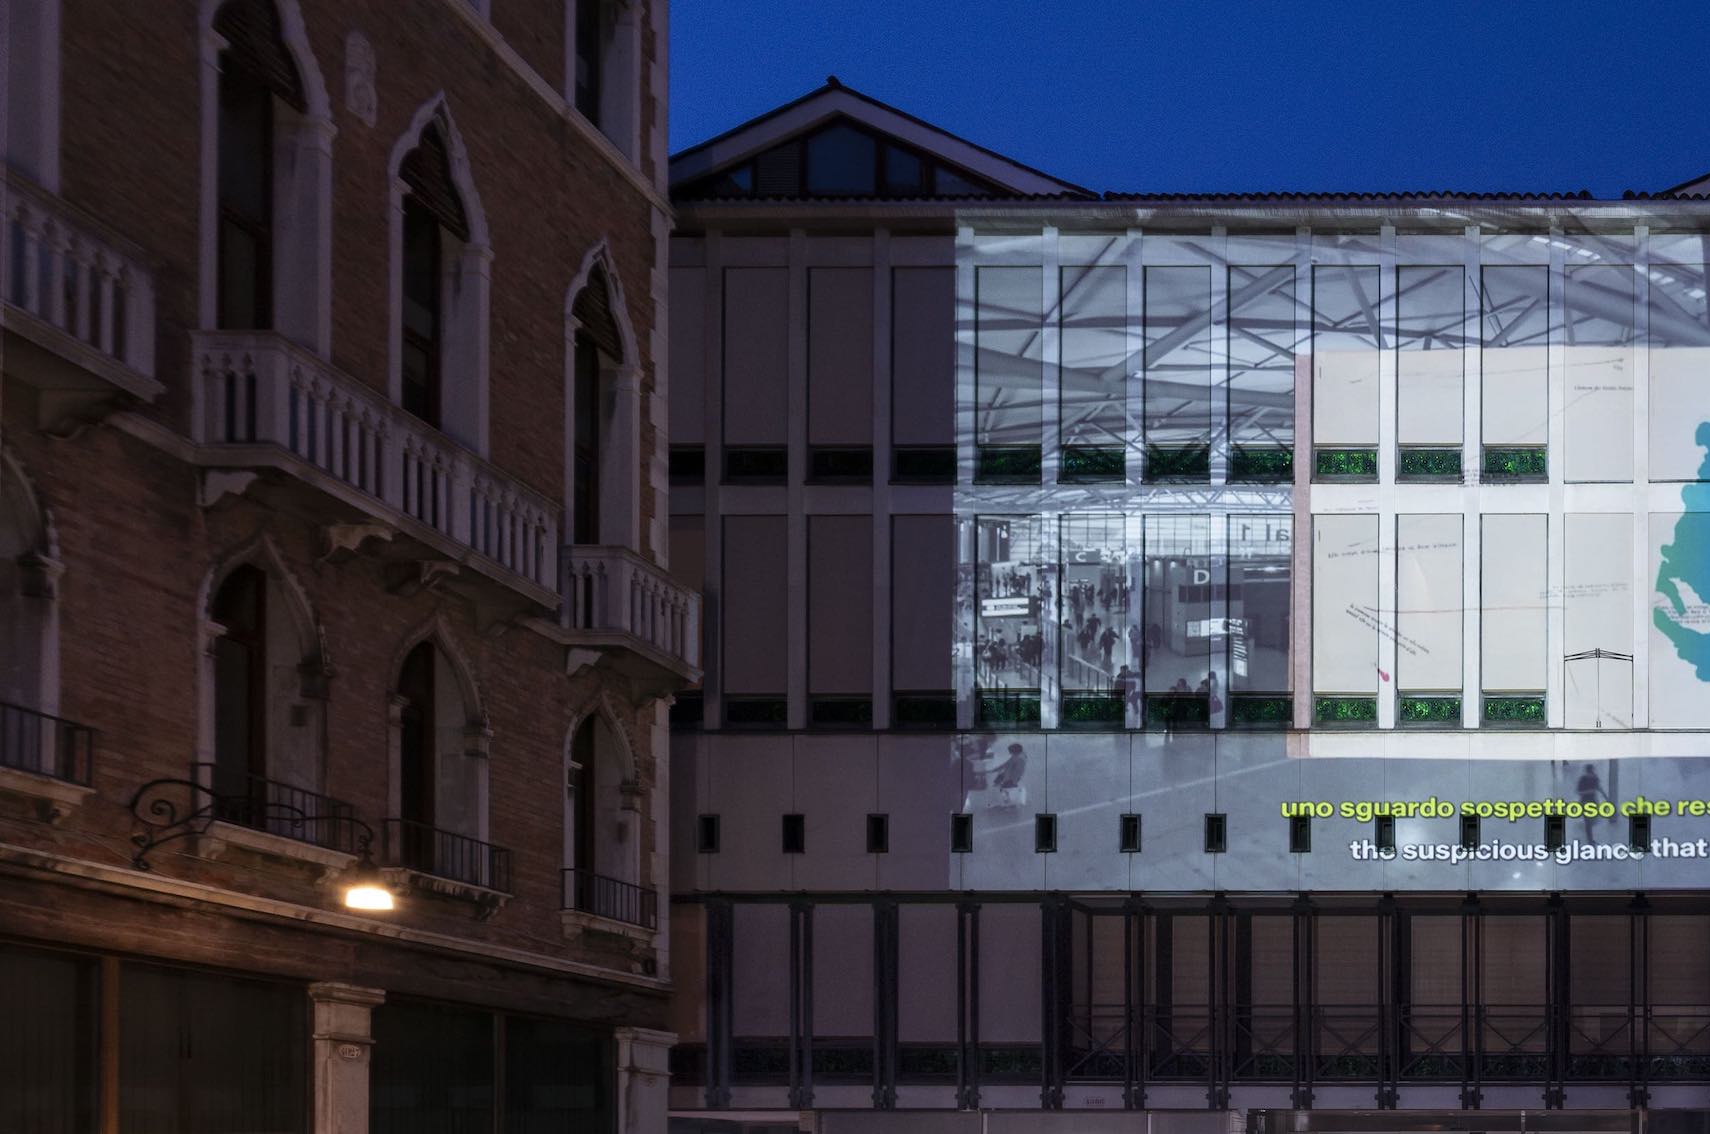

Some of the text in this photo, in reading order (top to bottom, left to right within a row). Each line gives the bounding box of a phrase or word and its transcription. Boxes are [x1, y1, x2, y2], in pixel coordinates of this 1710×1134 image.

[1193, 569, 1210, 585] D
[1280, 799, 1334, 818] uno
[1340, 796, 1453, 821] sguardo
[1460, 798, 1616, 821] sospettoso
[1620, 796, 1670, 816] che
[1402, 838, 1549, 864] suspicious
[1651, 837, 1708, 858] that
